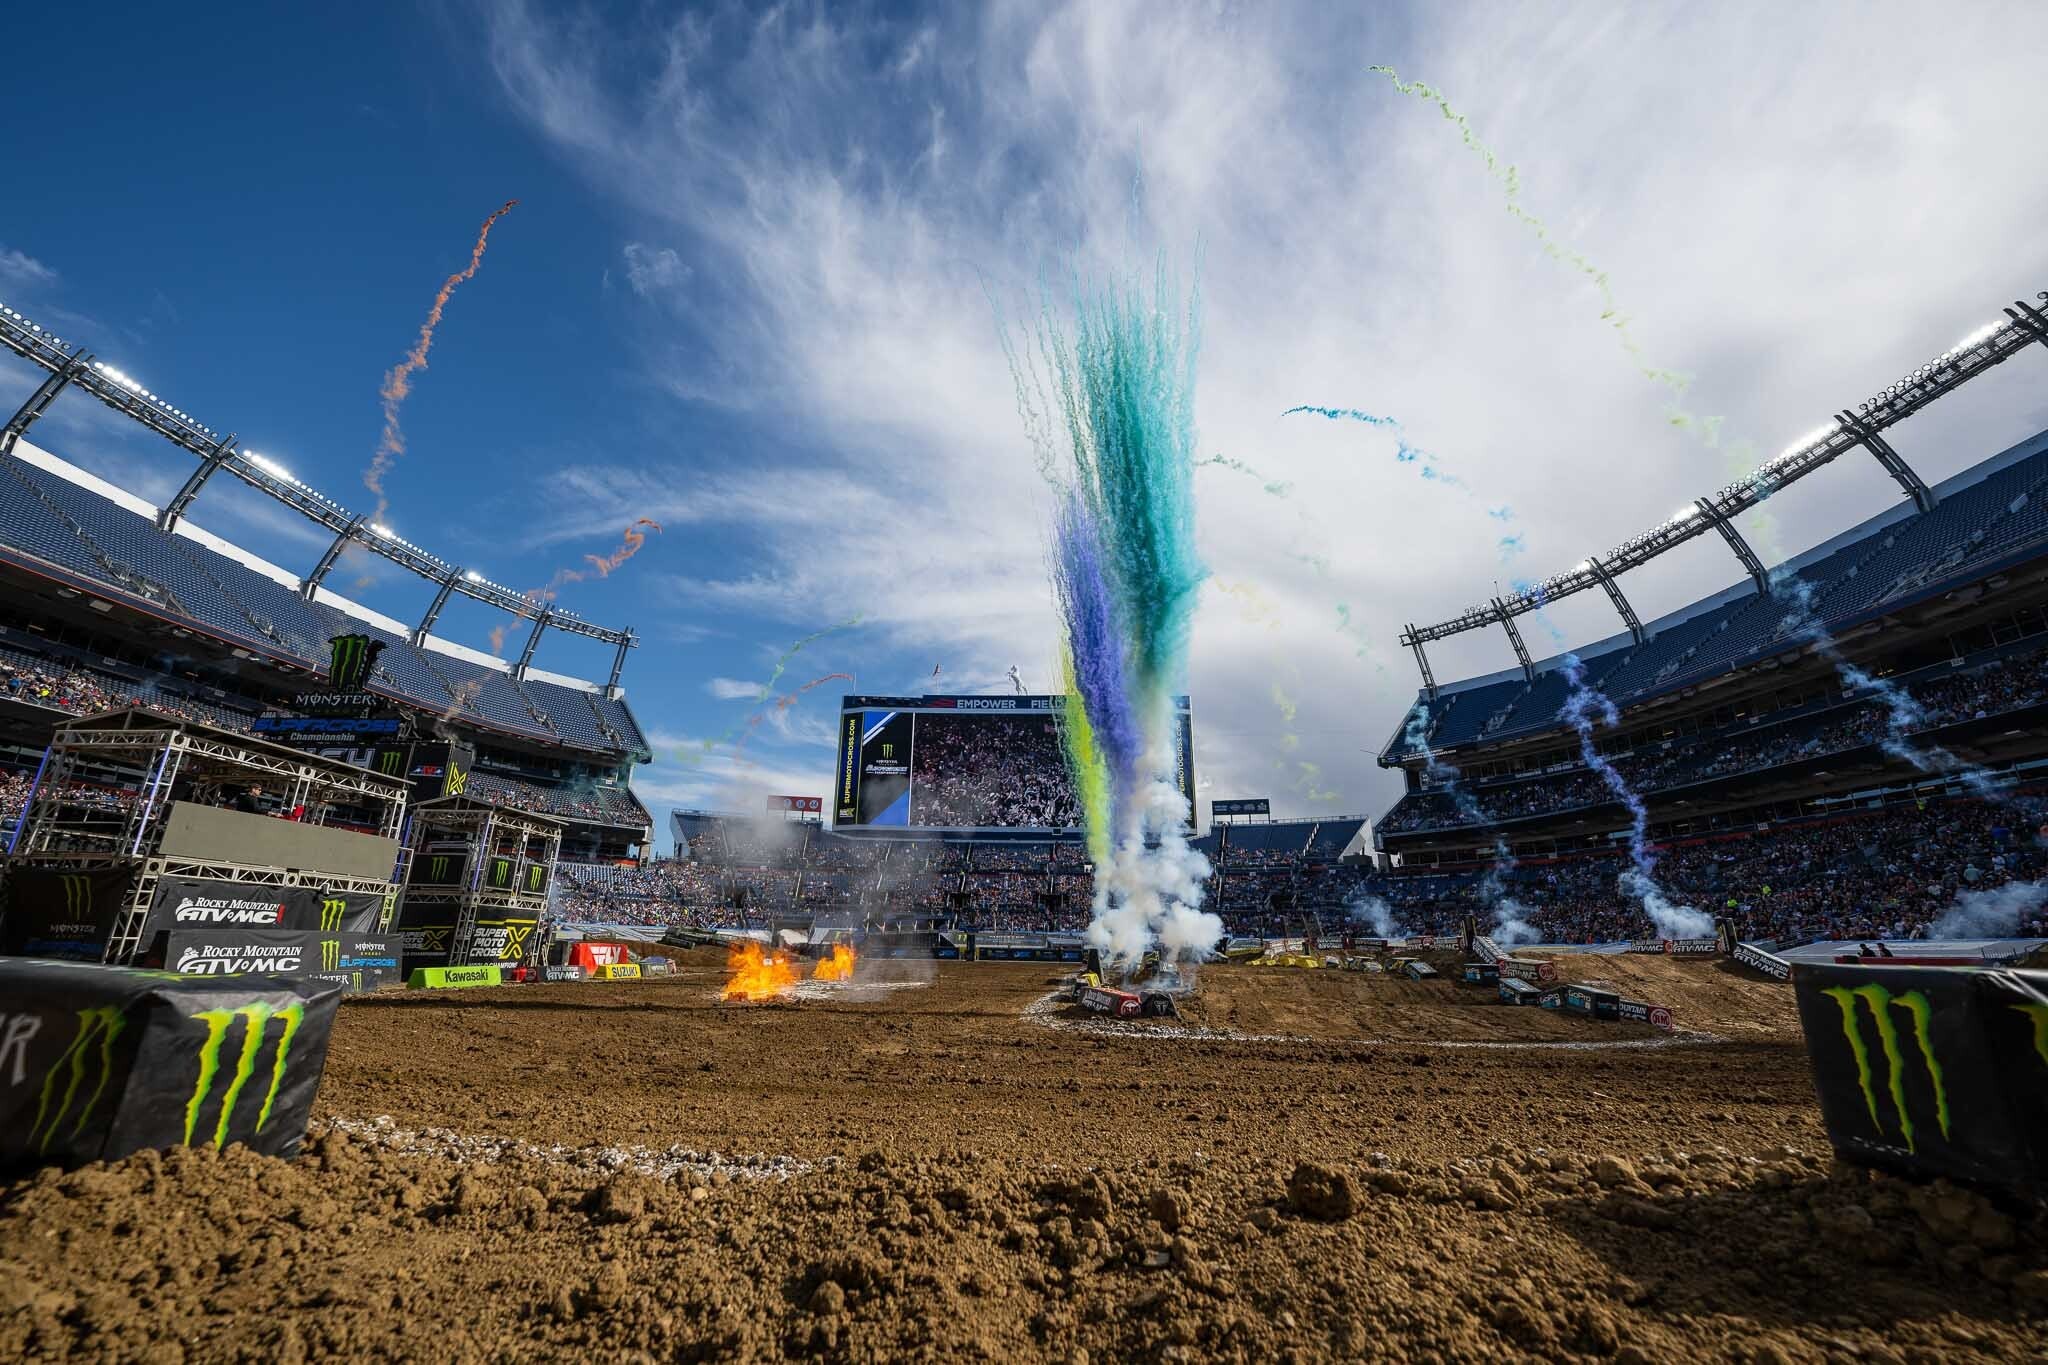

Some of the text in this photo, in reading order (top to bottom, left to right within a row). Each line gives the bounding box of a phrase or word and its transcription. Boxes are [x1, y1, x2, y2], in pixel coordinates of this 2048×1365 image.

[957, 699, 1016, 709] EMPOWER
[290, 732, 356, 742] Championship
[844, 719, 856, 804] SUPERMOTOCROSS.COM
[195, 896, 280, 911] ROCKY MOUNTAIN
[474, 927, 508, 938] SUPER
[474, 938, 504, 947] MOTO
[201, 945, 303, 958] ROCKY MOUNTAIN
[469, 947, 504, 957] CROSS
[590, 946, 621, 965] FLY
[444, 969, 489, 983] Kawasaki
[612, 966, 638, 978] SUZUKI
[1620, 1003, 1647, 1015] OUNTAIN
